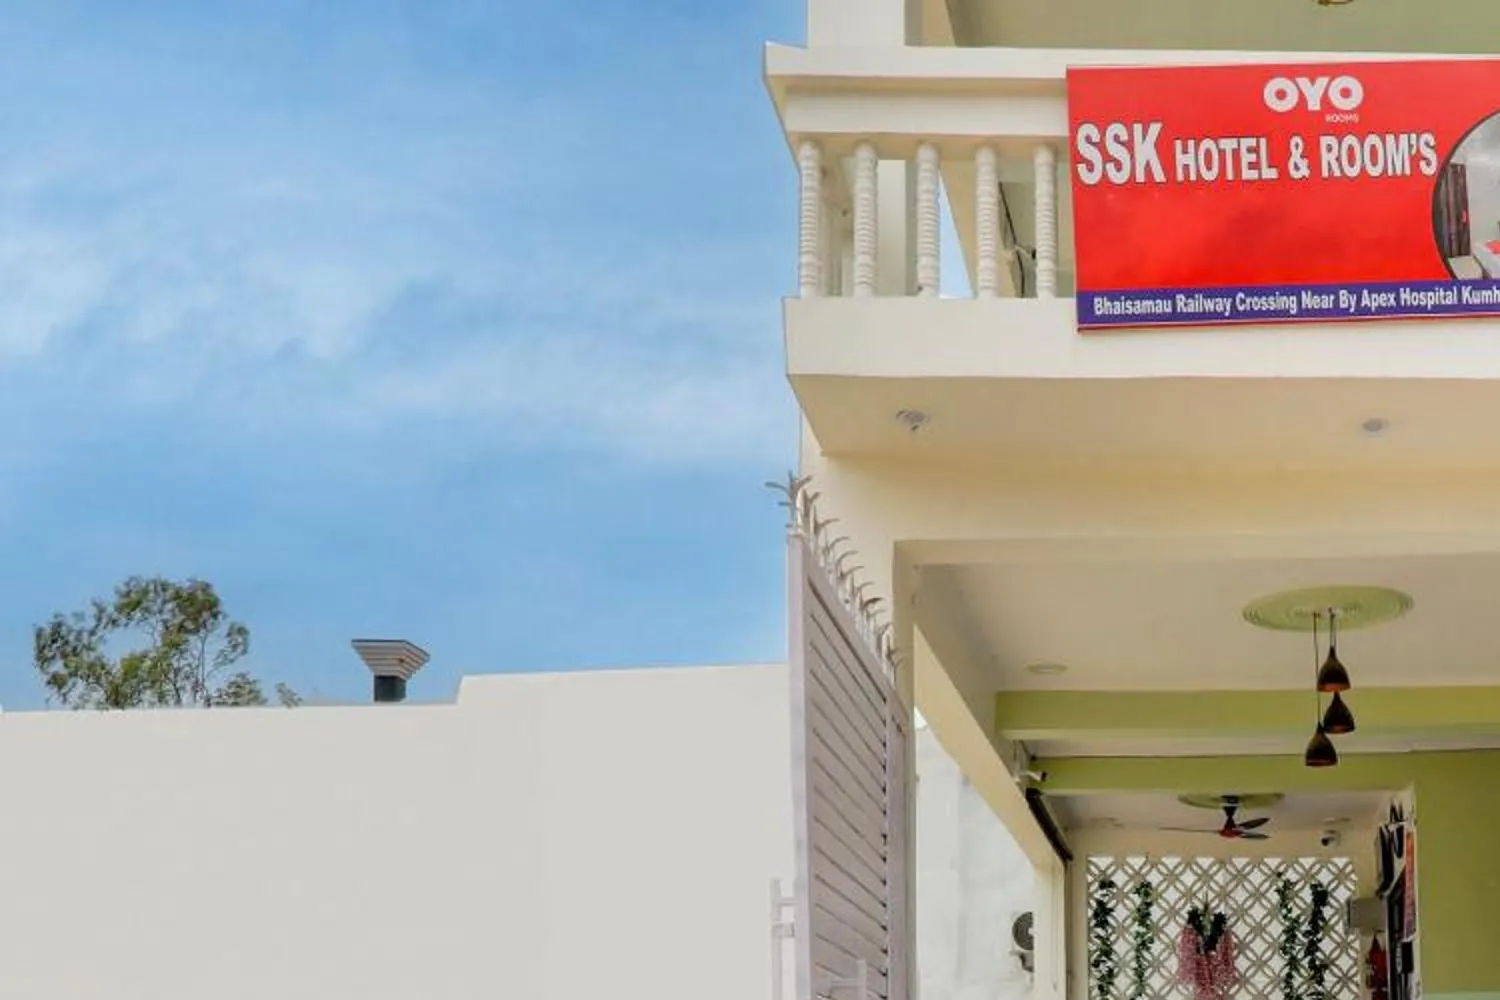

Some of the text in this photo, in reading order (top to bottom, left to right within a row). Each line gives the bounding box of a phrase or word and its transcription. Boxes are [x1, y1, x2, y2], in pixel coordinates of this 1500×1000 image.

[1263, 75, 1364, 112] OYO
[1076, 122, 1438, 185] SSK HOTEL & ROOM'S
[1093, 296, 1173, 316] Bhaisamau
[1176, 293, 1232, 316] Railway
[1235, 292, 1297, 314] Crossing
[1301, 290, 1334, 309] Near
[1339, 289, 1356, 312] By
[1361, 289, 1396, 312] Apex
[1400, 287, 1458, 310] Hospital
